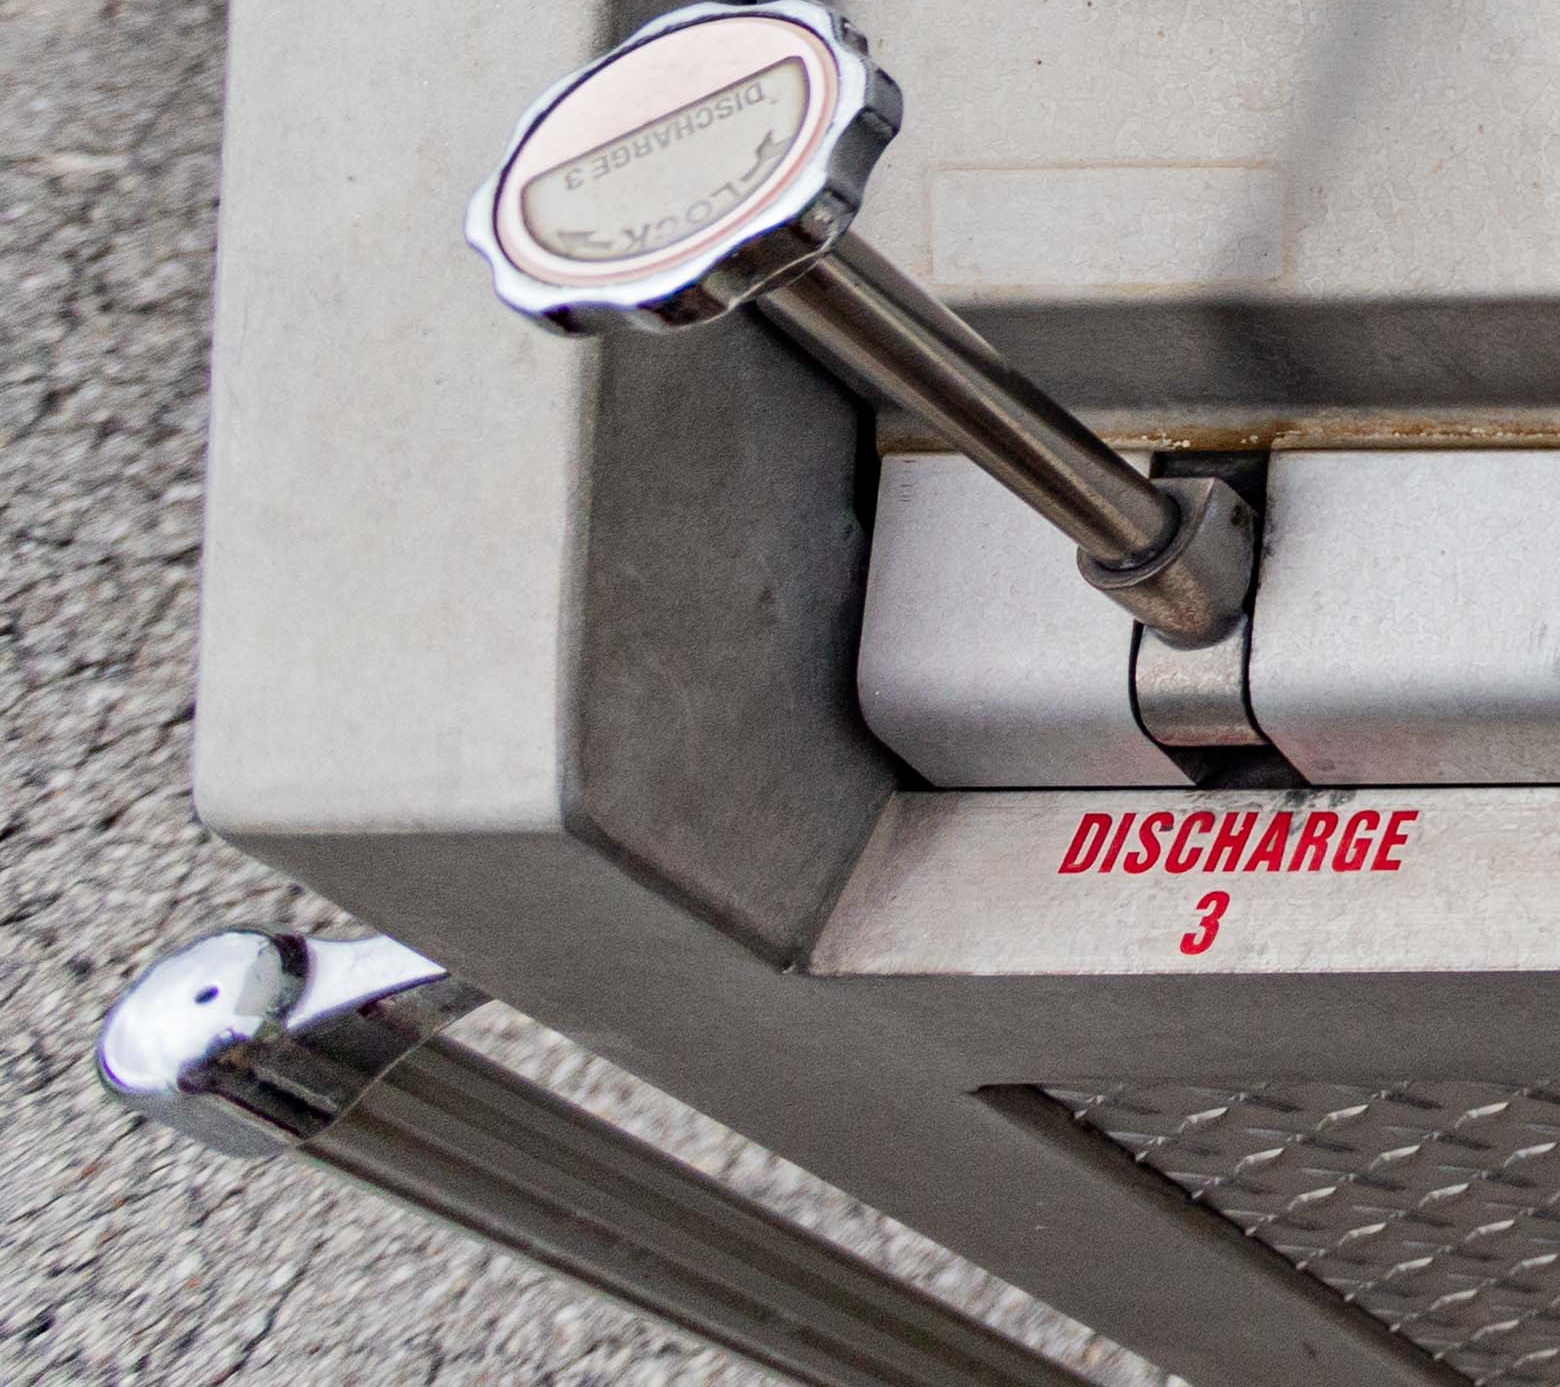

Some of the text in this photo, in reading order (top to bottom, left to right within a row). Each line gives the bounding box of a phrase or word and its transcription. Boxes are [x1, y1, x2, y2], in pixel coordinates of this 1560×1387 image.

[564, 80, 768, 192] DISCHARGE 3
[625, 180, 742, 254] LOCK
[1058, 810, 1419, 874] DISCHARGE
[1179, 891, 1230, 955] 3
